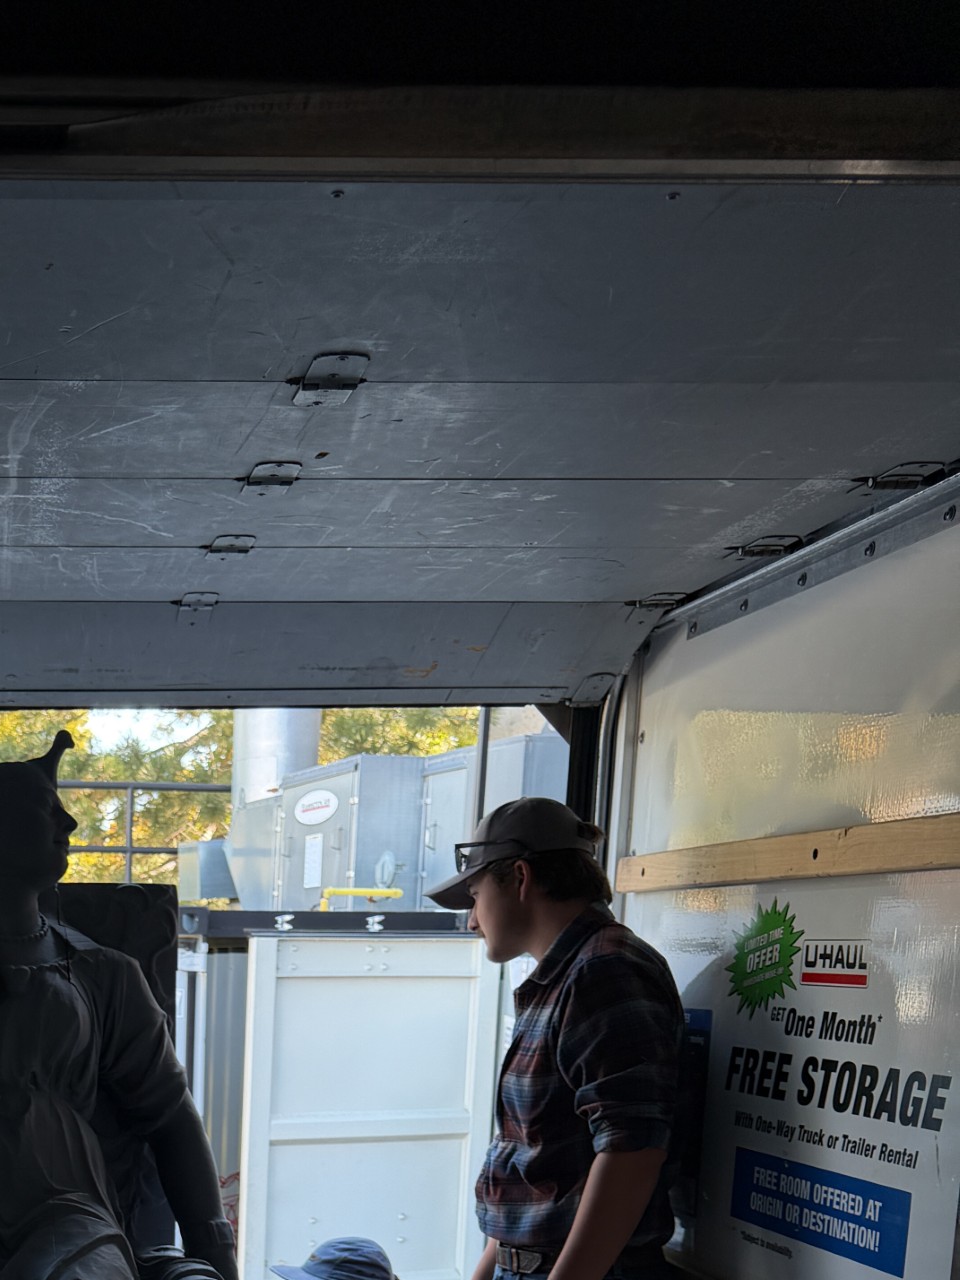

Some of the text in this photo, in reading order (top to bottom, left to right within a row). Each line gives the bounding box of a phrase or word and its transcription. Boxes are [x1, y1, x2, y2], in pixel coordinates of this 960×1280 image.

[744, 926, 785, 952] LIMITED TIME
[746, 943, 780, 973] OFFER
[804, 944, 868, 970] U-HAUL
[770, 1006, 786, 1022] GET
[784, 1008, 815, 1038] One
[724, 1046, 952, 1132] FREE STORAGE
[734, 1110, 919, 1170] With One-Way Truck or Trailer Rental
[753, 1166, 883, 1222] FREE ROOM OFFERED AT
[749, 1191, 881, 1252] ORIGIN OR DESTINATION!
